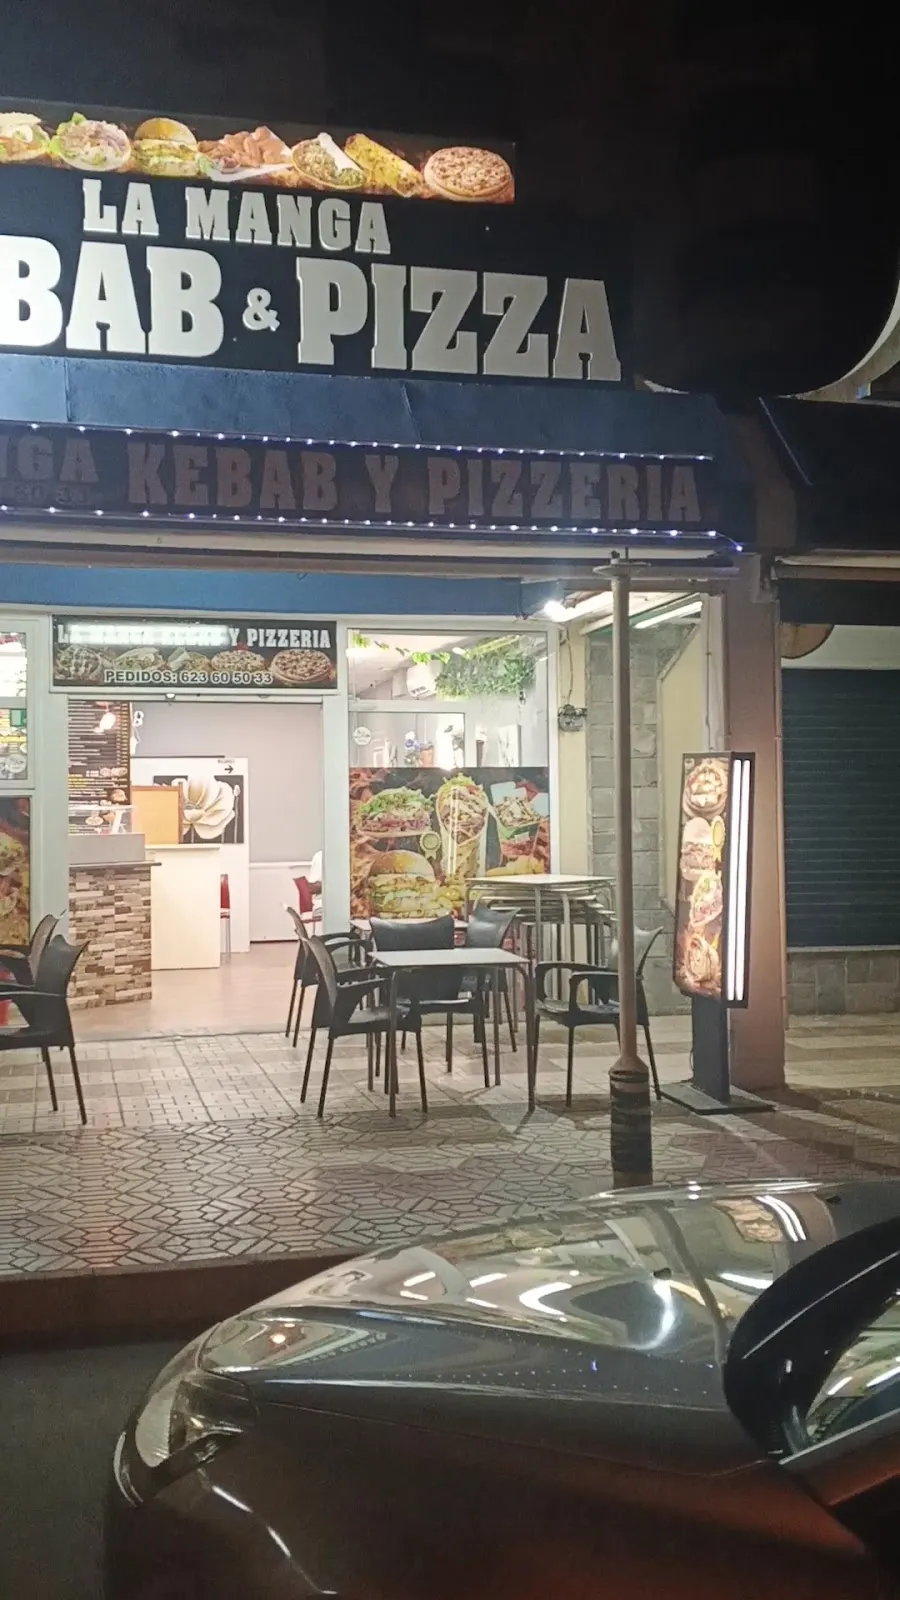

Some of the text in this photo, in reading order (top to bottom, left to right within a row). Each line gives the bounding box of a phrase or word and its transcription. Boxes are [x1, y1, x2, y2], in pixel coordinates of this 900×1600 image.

[82, 179, 391, 255] LA MANGA
[242, 288, 281, 332] &
[296, 256, 622, 382] PIZZA
[127, 442, 338, 511] KEBAB
[365, 454, 400, 514] Y
[427, 456, 701, 522] PIZZERIA
[228, 627, 240, 647] Y
[247, 628, 331, 649] PIZZERIA
[104, 670, 273, 685] PEDIDOS: 623 60 50 33
